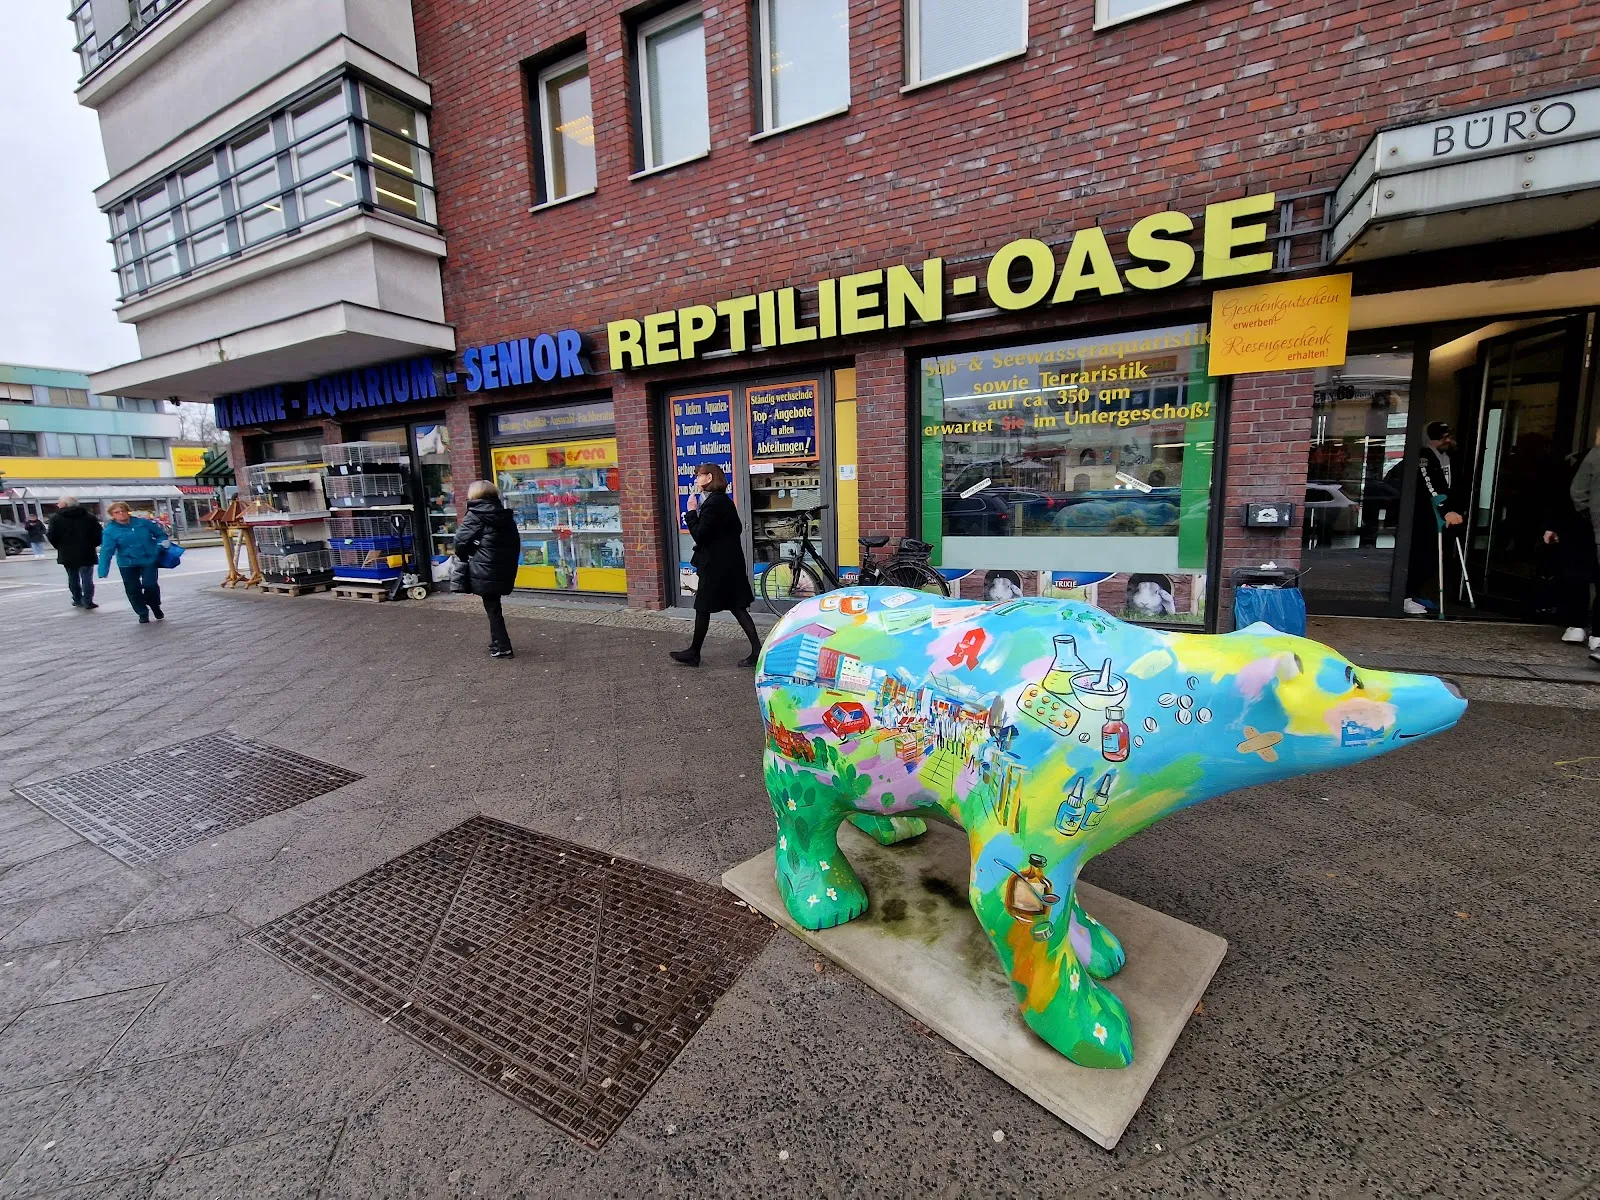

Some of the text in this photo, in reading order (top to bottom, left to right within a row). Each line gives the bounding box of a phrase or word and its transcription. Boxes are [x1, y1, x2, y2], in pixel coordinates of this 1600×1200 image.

[1432, 102, 1577, 156] BÜRO
[606, 191, 1278, 371] REPTILIEN-OASE
[1221, 285, 1340, 325] Geschenkgutschein
[1233, 316, 1277, 330] erwerben!
[992, 330, 1211, 369] Seewasseraquaristik
[1220, 326, 1334, 363] Riesengeschenk
[1287, 348, 1329, 361] erhalten!
[306, 357, 438, 417] AQUARIUM
[463, 328, 585, 393] SENIOR
[973, 375, 1029, 395] sowie
[1039, 361, 1150, 389] Terraristik
[750, 388, 814, 405] Ständig wechselnde
[987, 386, 1131, 412] auf ca. 350 qm
[752, 411, 768, 424] Top
[773, 406, 813, 422] Angebote
[924, 402, 1211, 437] erwartet Sie im Untergeschoß!
[710, 420, 730, 437] Anlagen
[770, 424, 795, 436] in allen
[686, 441, 697, 456] und
[699, 440, 731, 456] installieren
[756, 436, 812, 455] Abteilungen!
[1054, 580, 1077, 588] TRIXIE
